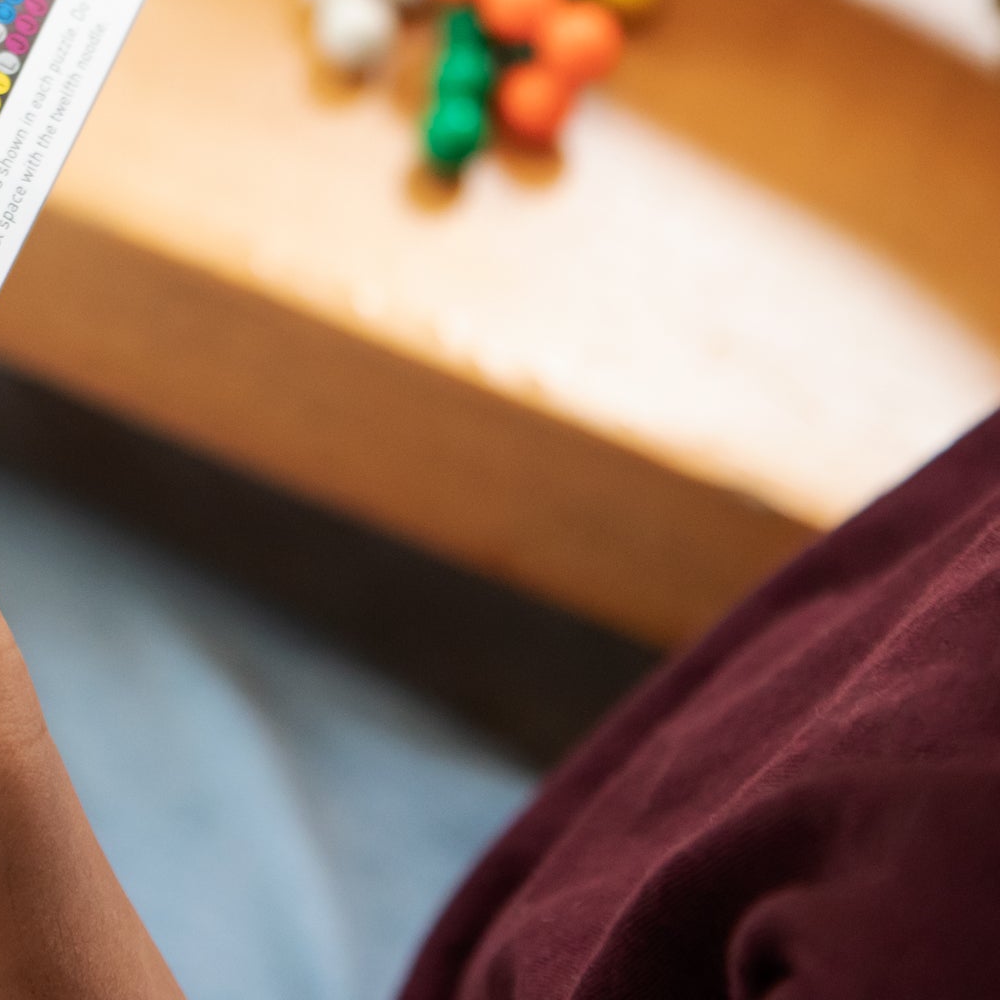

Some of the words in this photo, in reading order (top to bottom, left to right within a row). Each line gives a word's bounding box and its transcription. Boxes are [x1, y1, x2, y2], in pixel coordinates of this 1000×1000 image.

[23, 111, 35, 125] in
[31, 75, 53, 109] each
[21, 151, 42, 182] with
[36, 124, 56, 148] the
